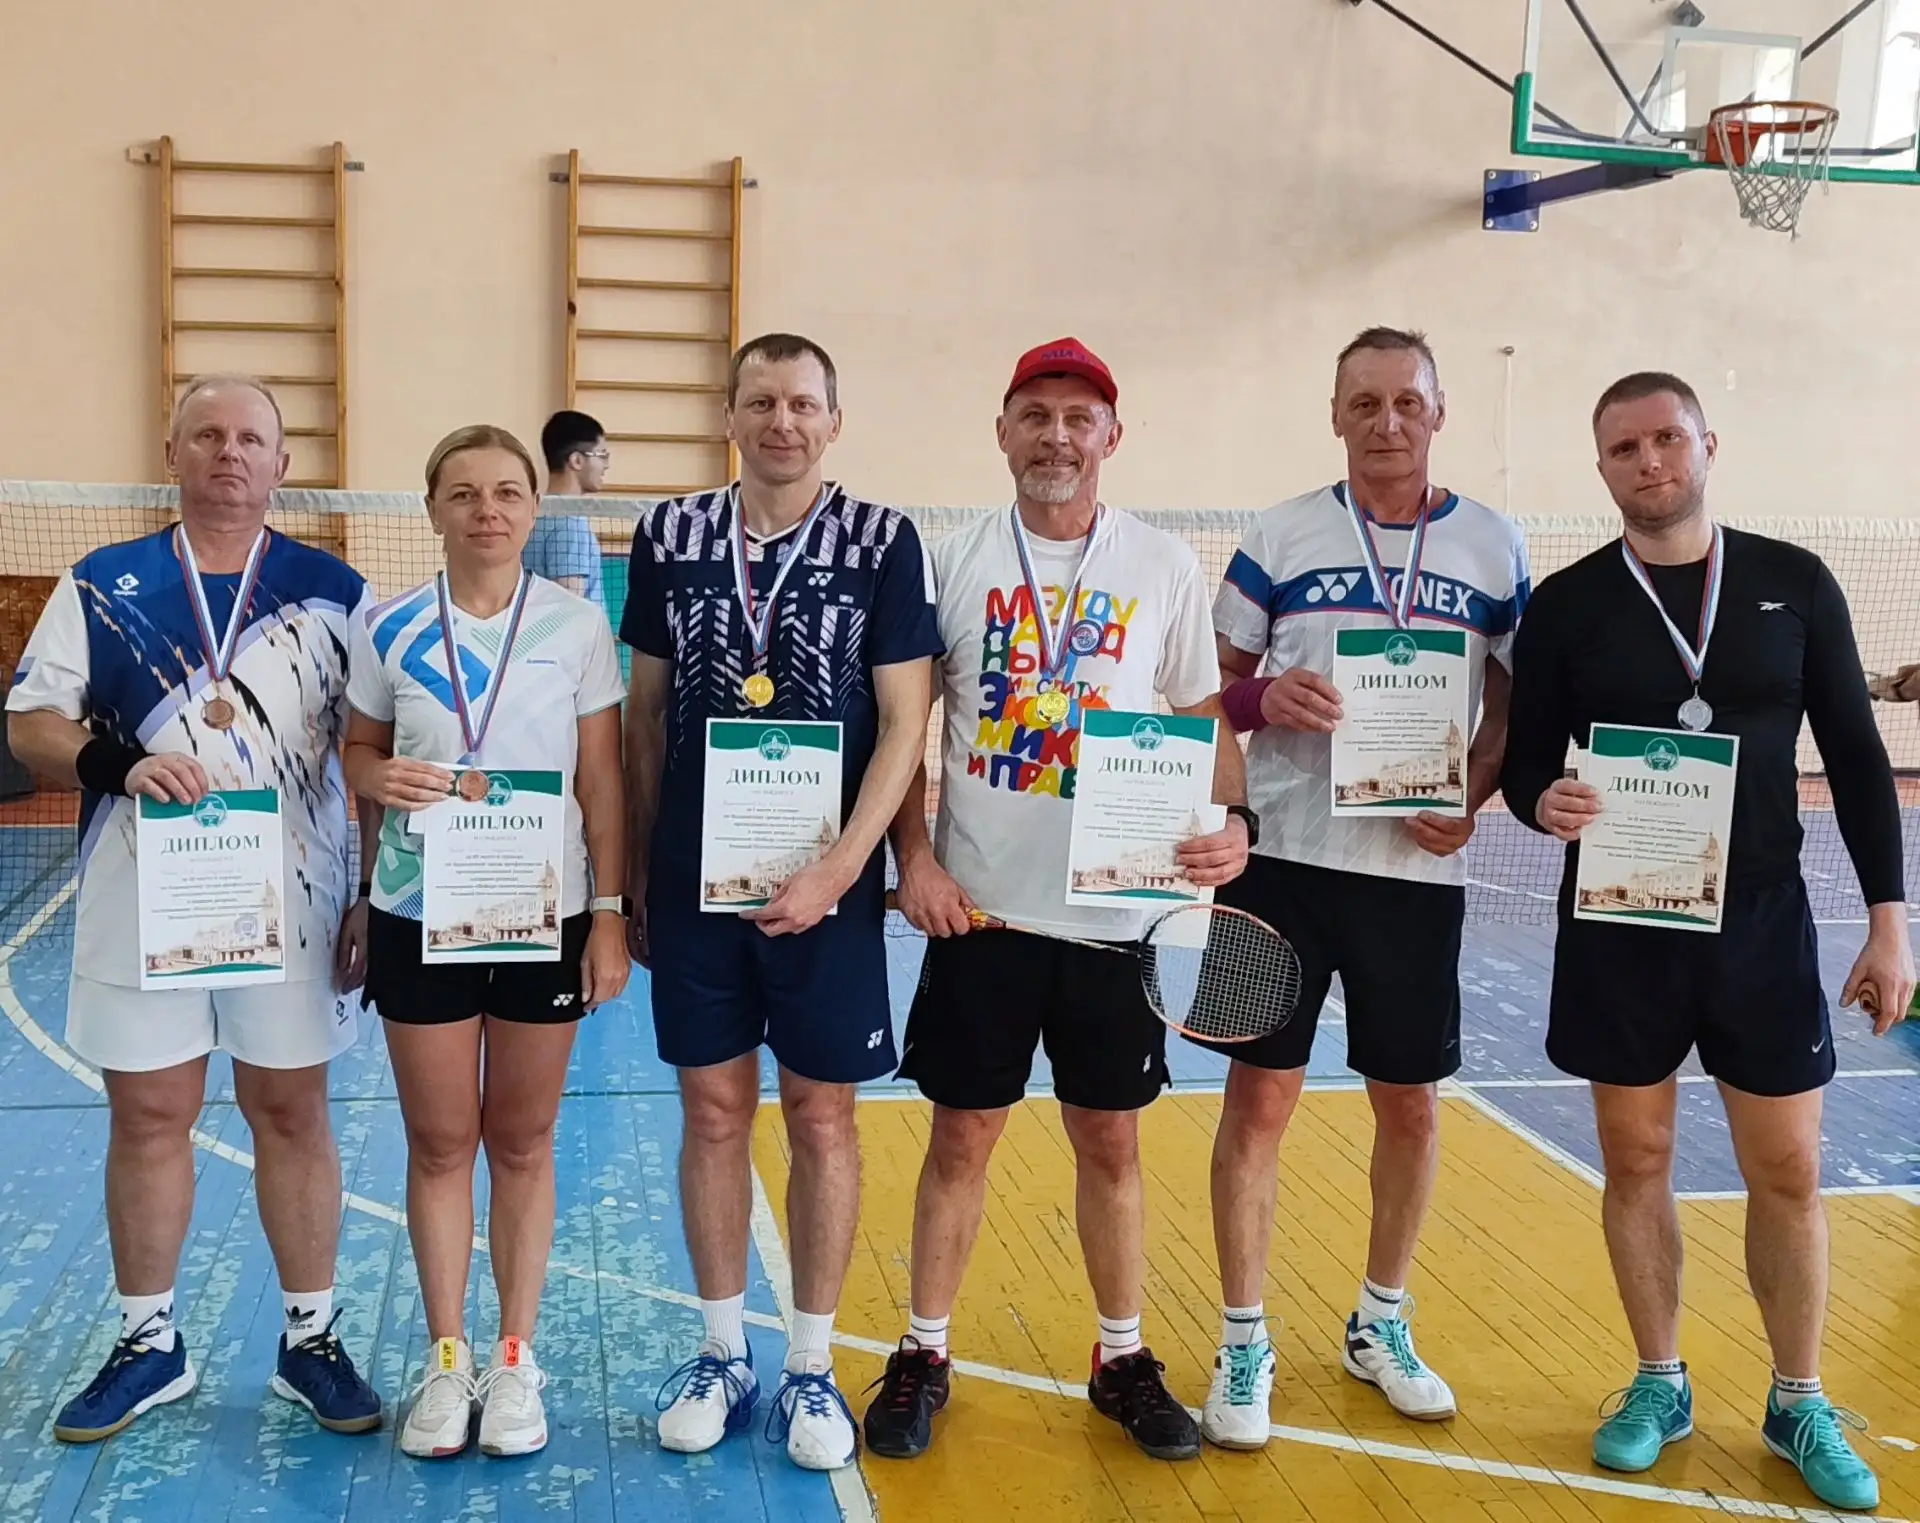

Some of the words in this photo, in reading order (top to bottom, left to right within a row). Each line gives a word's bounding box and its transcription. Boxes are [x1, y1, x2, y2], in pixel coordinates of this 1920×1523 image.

[1353, 674, 1448, 691] ДИПЛОМ
[1098, 756, 1193, 777] ДИПЛОМ
[725, 768, 821, 786] ДИПЛОМ
[1606, 775, 1710, 800] ДИПЛОМ
[447, 815, 544, 832] ДИПЛОМ
[160, 834, 261, 855] ДИПЛОМ
